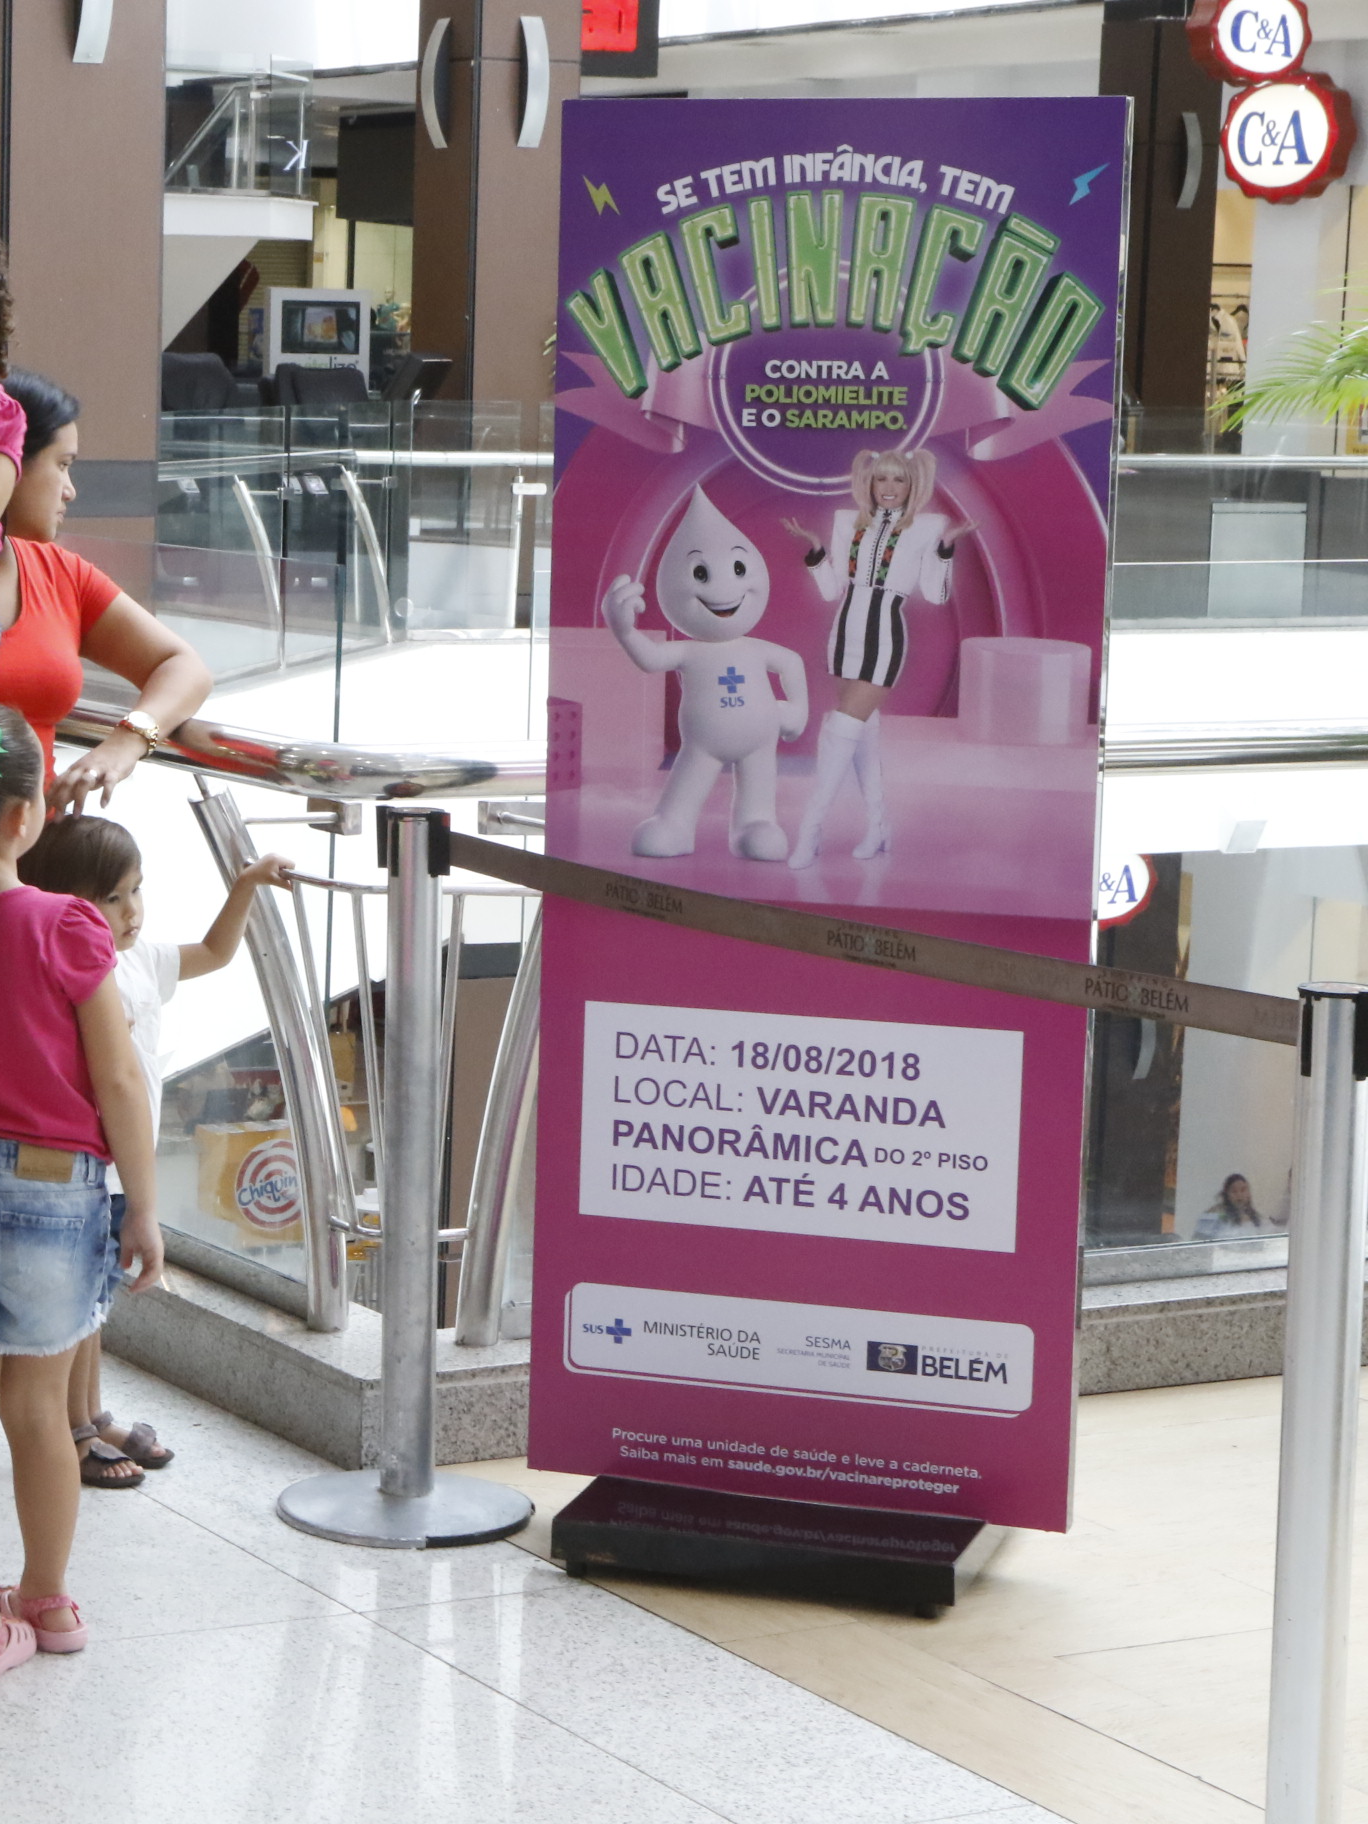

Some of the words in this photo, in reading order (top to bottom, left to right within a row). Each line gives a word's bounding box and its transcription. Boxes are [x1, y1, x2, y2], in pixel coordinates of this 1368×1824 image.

[1231, 10, 1293, 58] C&A
[1237, 110, 1313, 167] C&A
[656, 175, 695, 215] SE
[700, 157, 776, 198] TEM
[783, 144, 928, 193] INFÂNCIA,
[938, 165, 1015, 214] TEM
[566, 189, 1105, 411] VACINAÇÃO
[764, 359, 866, 380] CONTRA
[870, 361, 889, 380] A
[745, 383, 908, 406] POLIOMIELITE
[742, 409, 757, 427] E
[761, 409, 781, 428] O
[785, 409, 908, 430] SARAMPO.
[720, 696, 745, 708] SUS
[647, 891, 683, 914] BELÉM
[1098, 864, 1138, 904] &A
[827, 927, 865, 952] PÁTIO
[875, 938, 916, 962] BELÉM
[1085, 975, 1129, 1002] PÁTIO
[1140, 986, 1189, 1013] BELÉM
[614, 1031, 716, 1066] DATA:
[730, 1039, 921, 1081] 18/08/2018
[614, 1076, 744, 1113] LOCAL:
[756, 1086, 946, 1129] VARANDA
[612, 1119, 868, 1168] PANORÂMICA
[874, 1147, 905, 1166] DO
[938, 1152, 989, 1172] PISO
[237, 1171, 299, 1207] Chiquin
[611, 1163, 732, 1200] IDADE:
[743, 1172, 815, 1208] ATÉ
[827, 1183, 848, 1210] 4
[858, 1184, 970, 1222] ANOS
[582, 1323, 604, 1335] SUS
[643, 1320, 733, 1343] MINISTÉRIO
[737, 1330, 761, 1345] DA
[805, 1335, 851, 1351] SESMA
[707, 1341, 760, 1361] SAÚDE
[921, 1354, 1008, 1384] BELÉM
[612, 1427, 668, 1445] Procure
[671, 1437, 703, 1449] uma
[706, 1439, 766, 1456] unidade
[770, 1443, 789, 1458] de
[793, 1447, 837, 1464] saúde
[841, 1455, 850, 1465] e
[854, 1453, 885, 1469] leve
[889, 1460, 899, 1470] a
[902, 1458, 983, 1480] caderneta.
[619, 1445, 660, 1462] Saiba
[663, 1450, 697, 1465] mais
[701, 1456, 724, 1468] em
[727, 1458, 960, 1494] saude.gov.br/vacinareproteger
